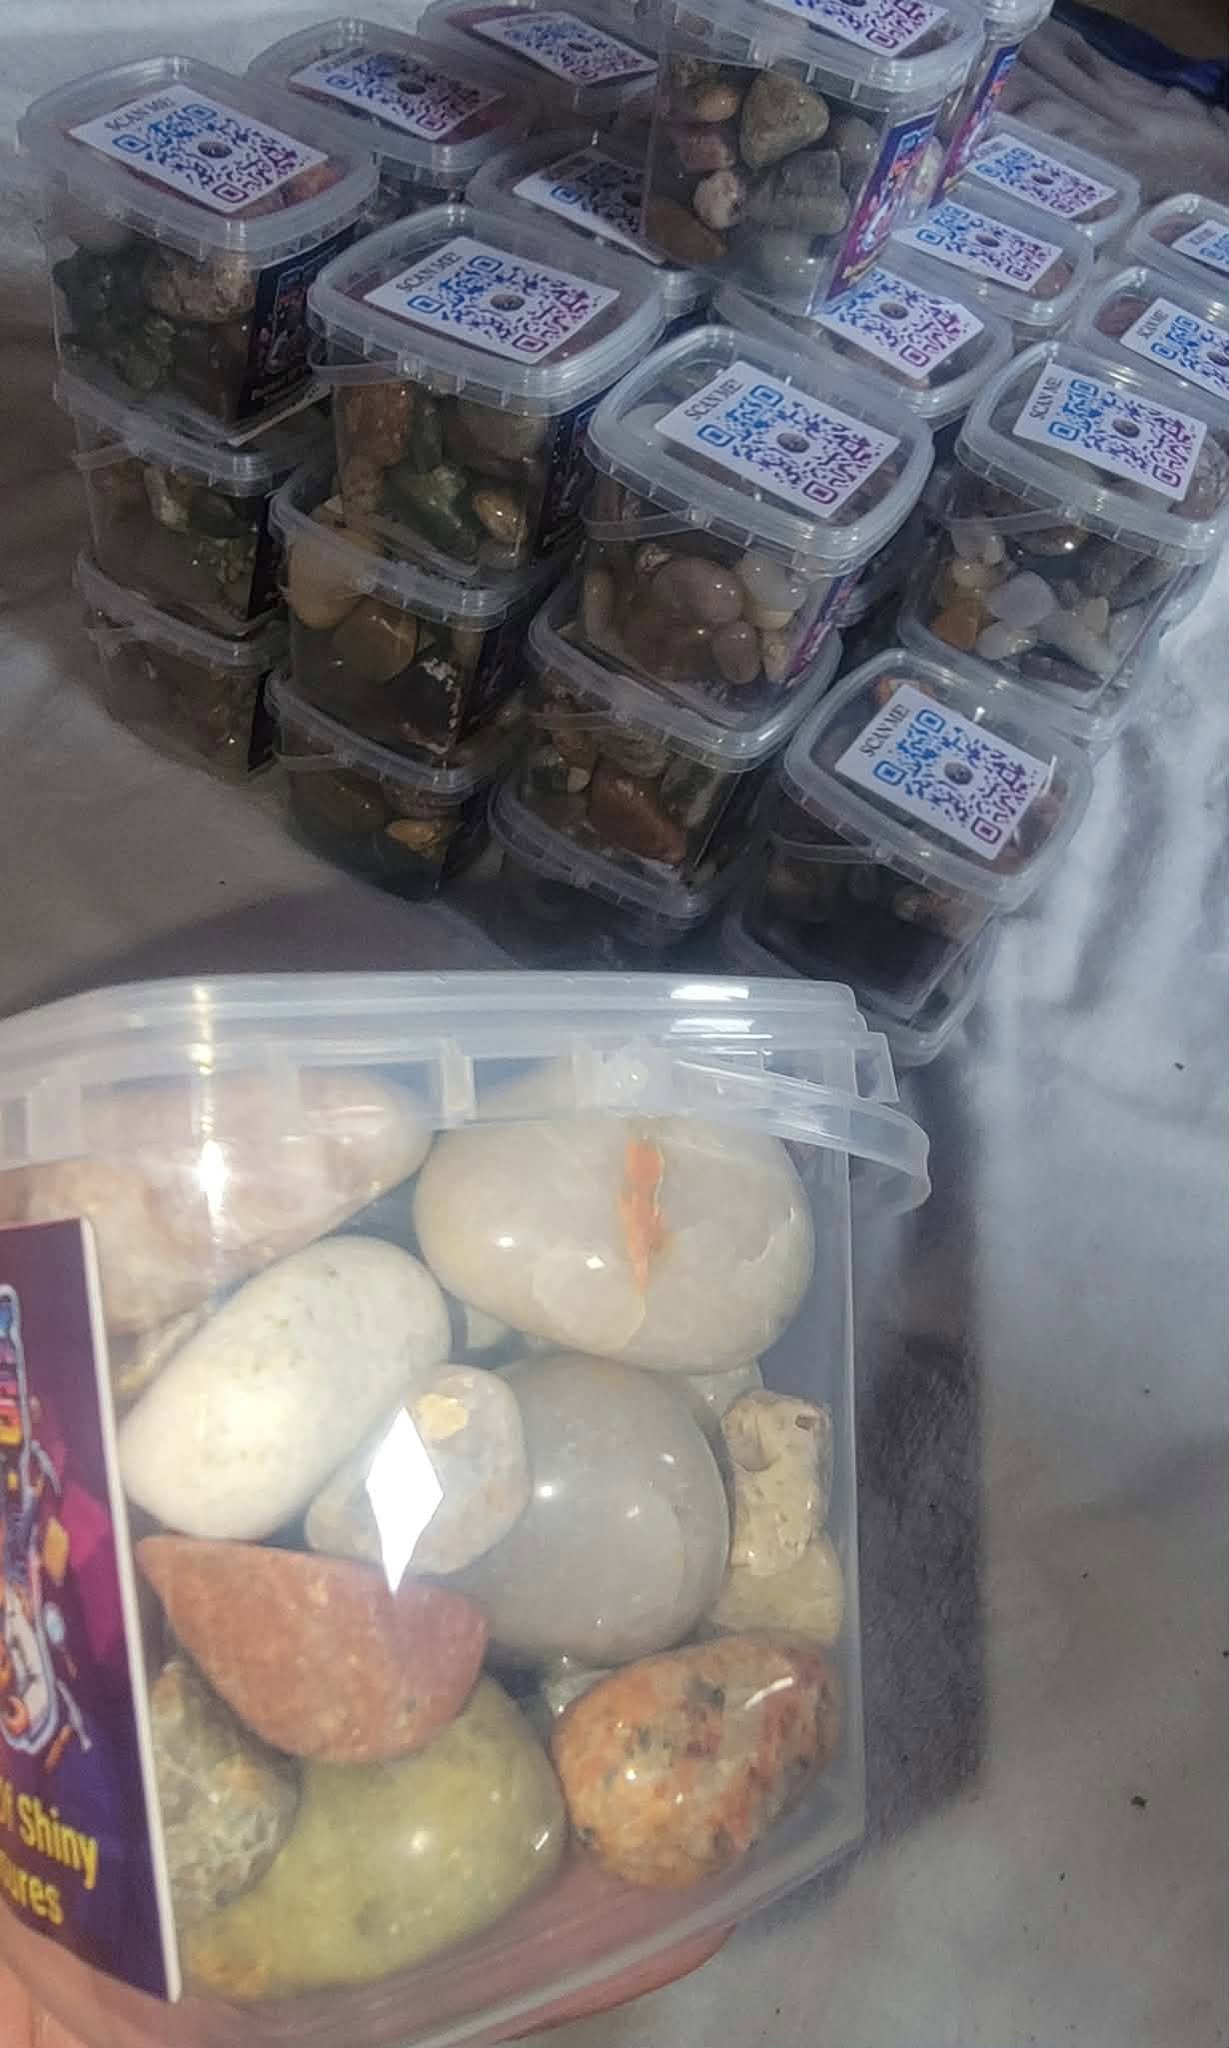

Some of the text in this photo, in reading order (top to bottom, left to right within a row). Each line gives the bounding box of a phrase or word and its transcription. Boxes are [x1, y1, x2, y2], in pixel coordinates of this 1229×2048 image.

[103, 107, 152, 131] SCAN
[395, 265, 440, 293] SCAN
[683, 392, 724, 421] SCAN
[1029, 391, 1053, 420] SCAN
[859, 722, 894, 758] SCAN
[17, 1793, 99, 1891] Shiny
